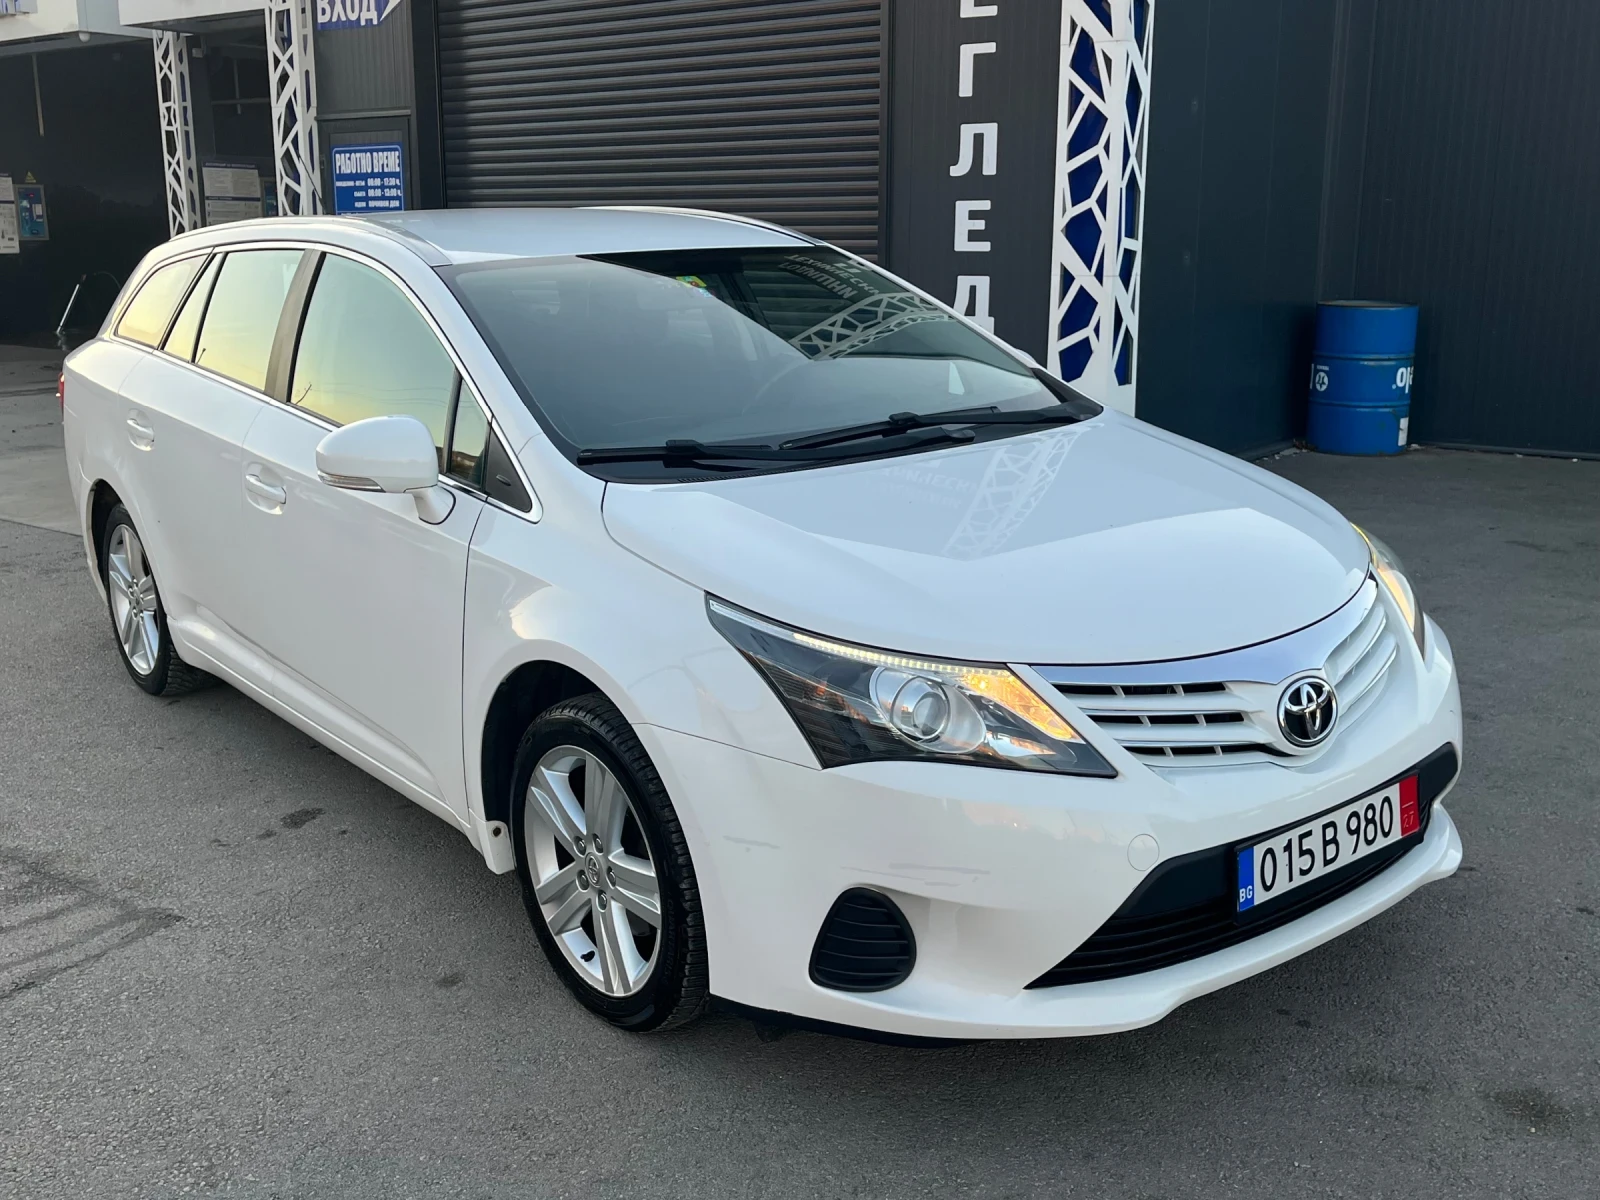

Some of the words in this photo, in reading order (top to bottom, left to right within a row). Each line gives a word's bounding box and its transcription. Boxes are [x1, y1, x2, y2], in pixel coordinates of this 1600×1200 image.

[317, 0, 378, 26] ВХОД
[335, 152, 372, 175] РАБОТНО
[373, 151, 400, 174] ВРЕМЕ
[1239, 885, 1253, 903] BG
